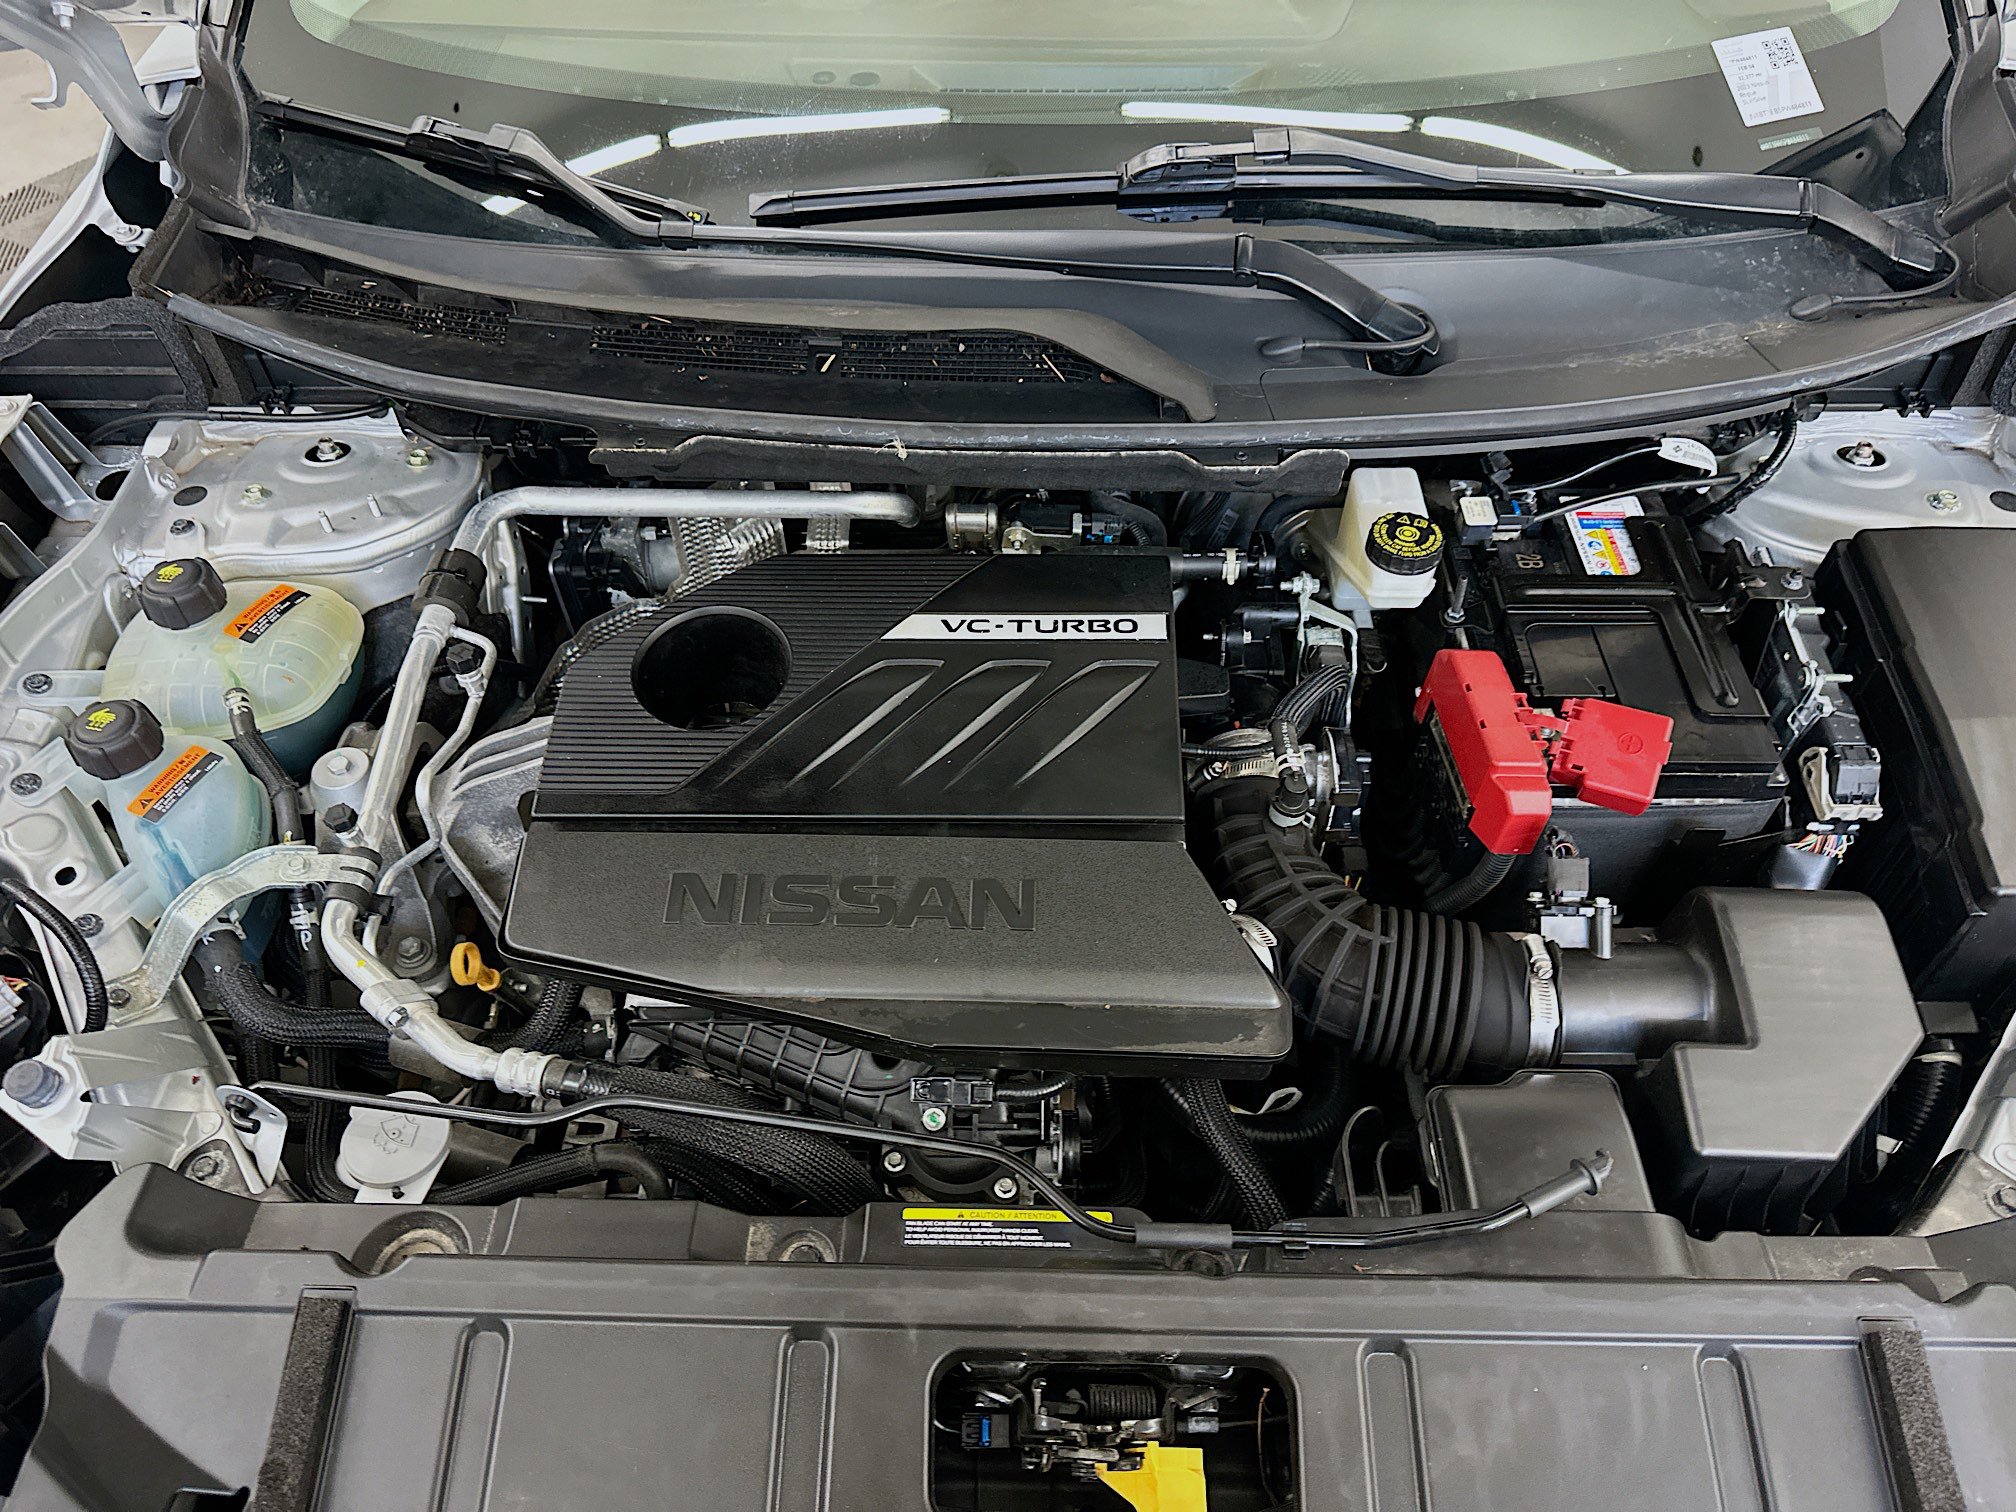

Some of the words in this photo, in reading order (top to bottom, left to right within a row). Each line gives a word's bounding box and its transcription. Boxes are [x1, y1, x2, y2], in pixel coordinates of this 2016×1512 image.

[1515, 553, 1544, 569] 2B
[940, 619, 1139, 634] VC-TURBO
[662, 872, 1036, 931] NISSAN
[1014, 1212, 1057, 1220] ATTENTION
